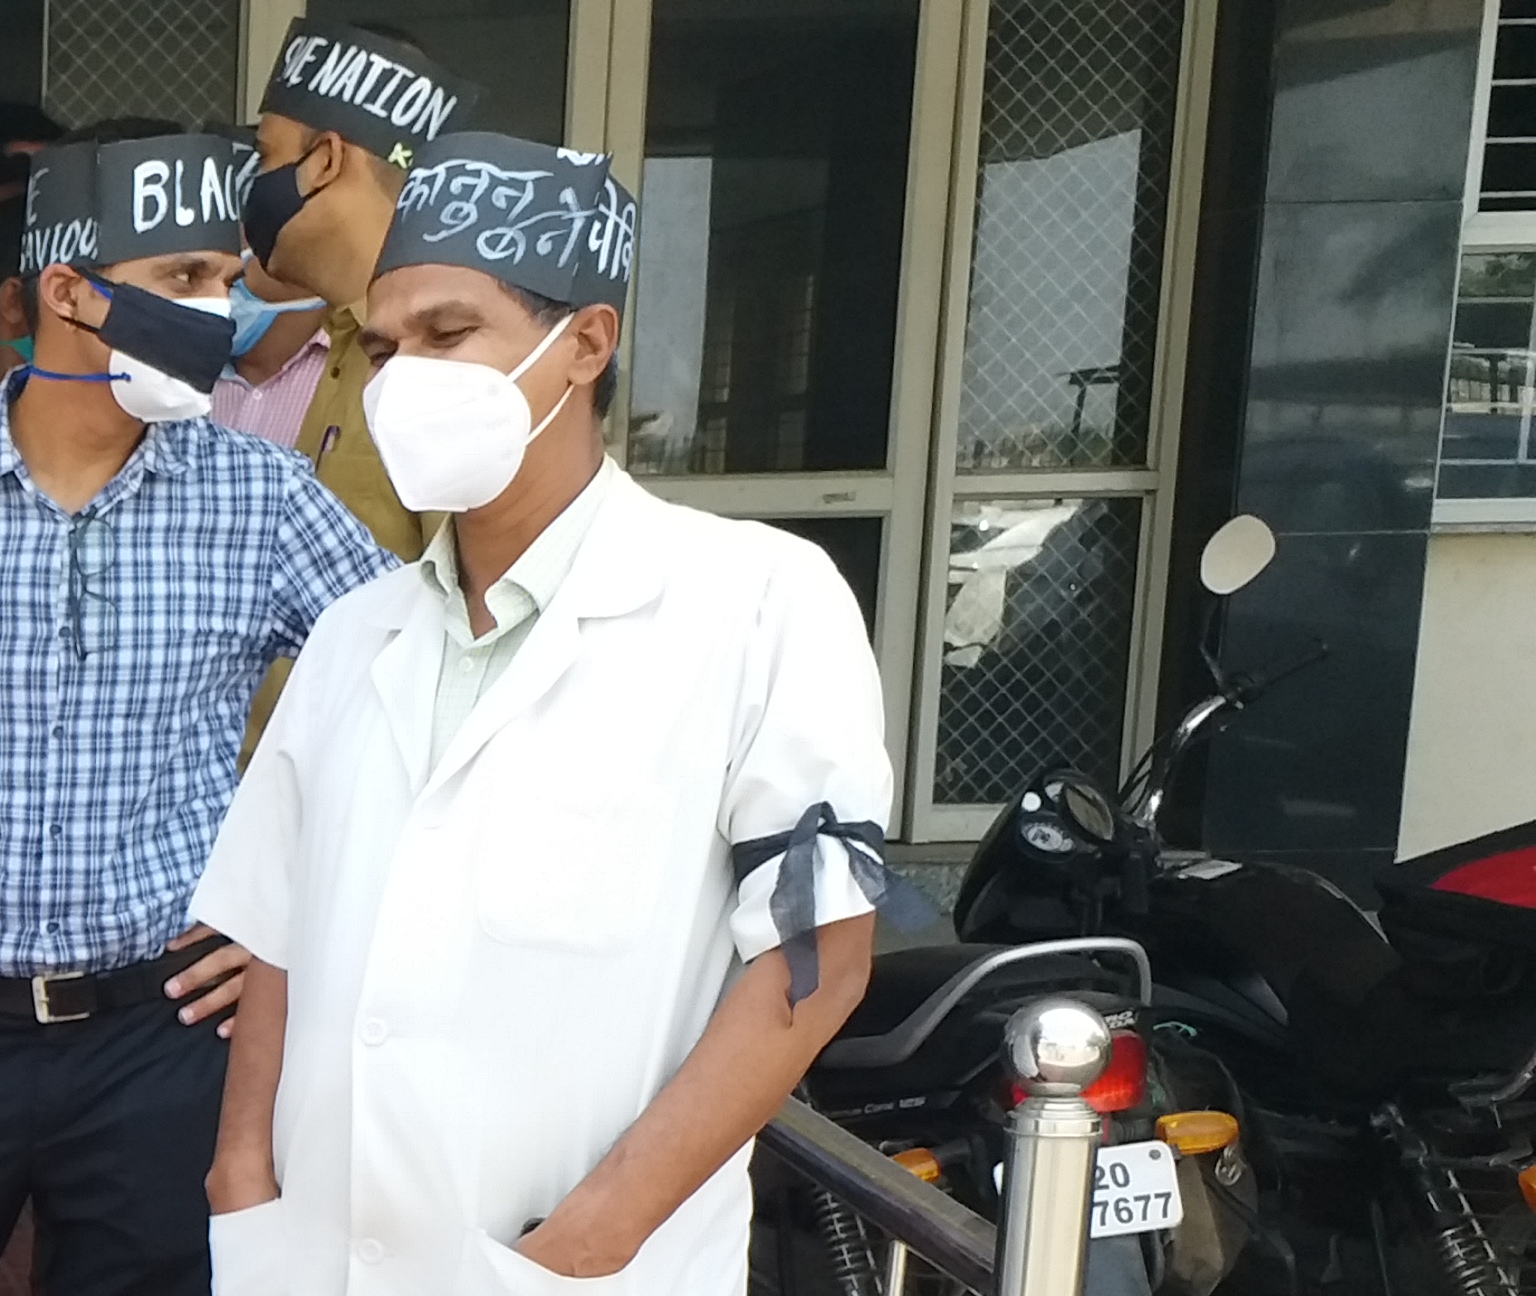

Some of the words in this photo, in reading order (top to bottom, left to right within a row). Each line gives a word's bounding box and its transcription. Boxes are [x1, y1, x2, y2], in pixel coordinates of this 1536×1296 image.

[307, 40, 458, 142] NATION
[1094, 1161, 1131, 1191] 20
[1092, 1191, 1173, 1228] 7677
